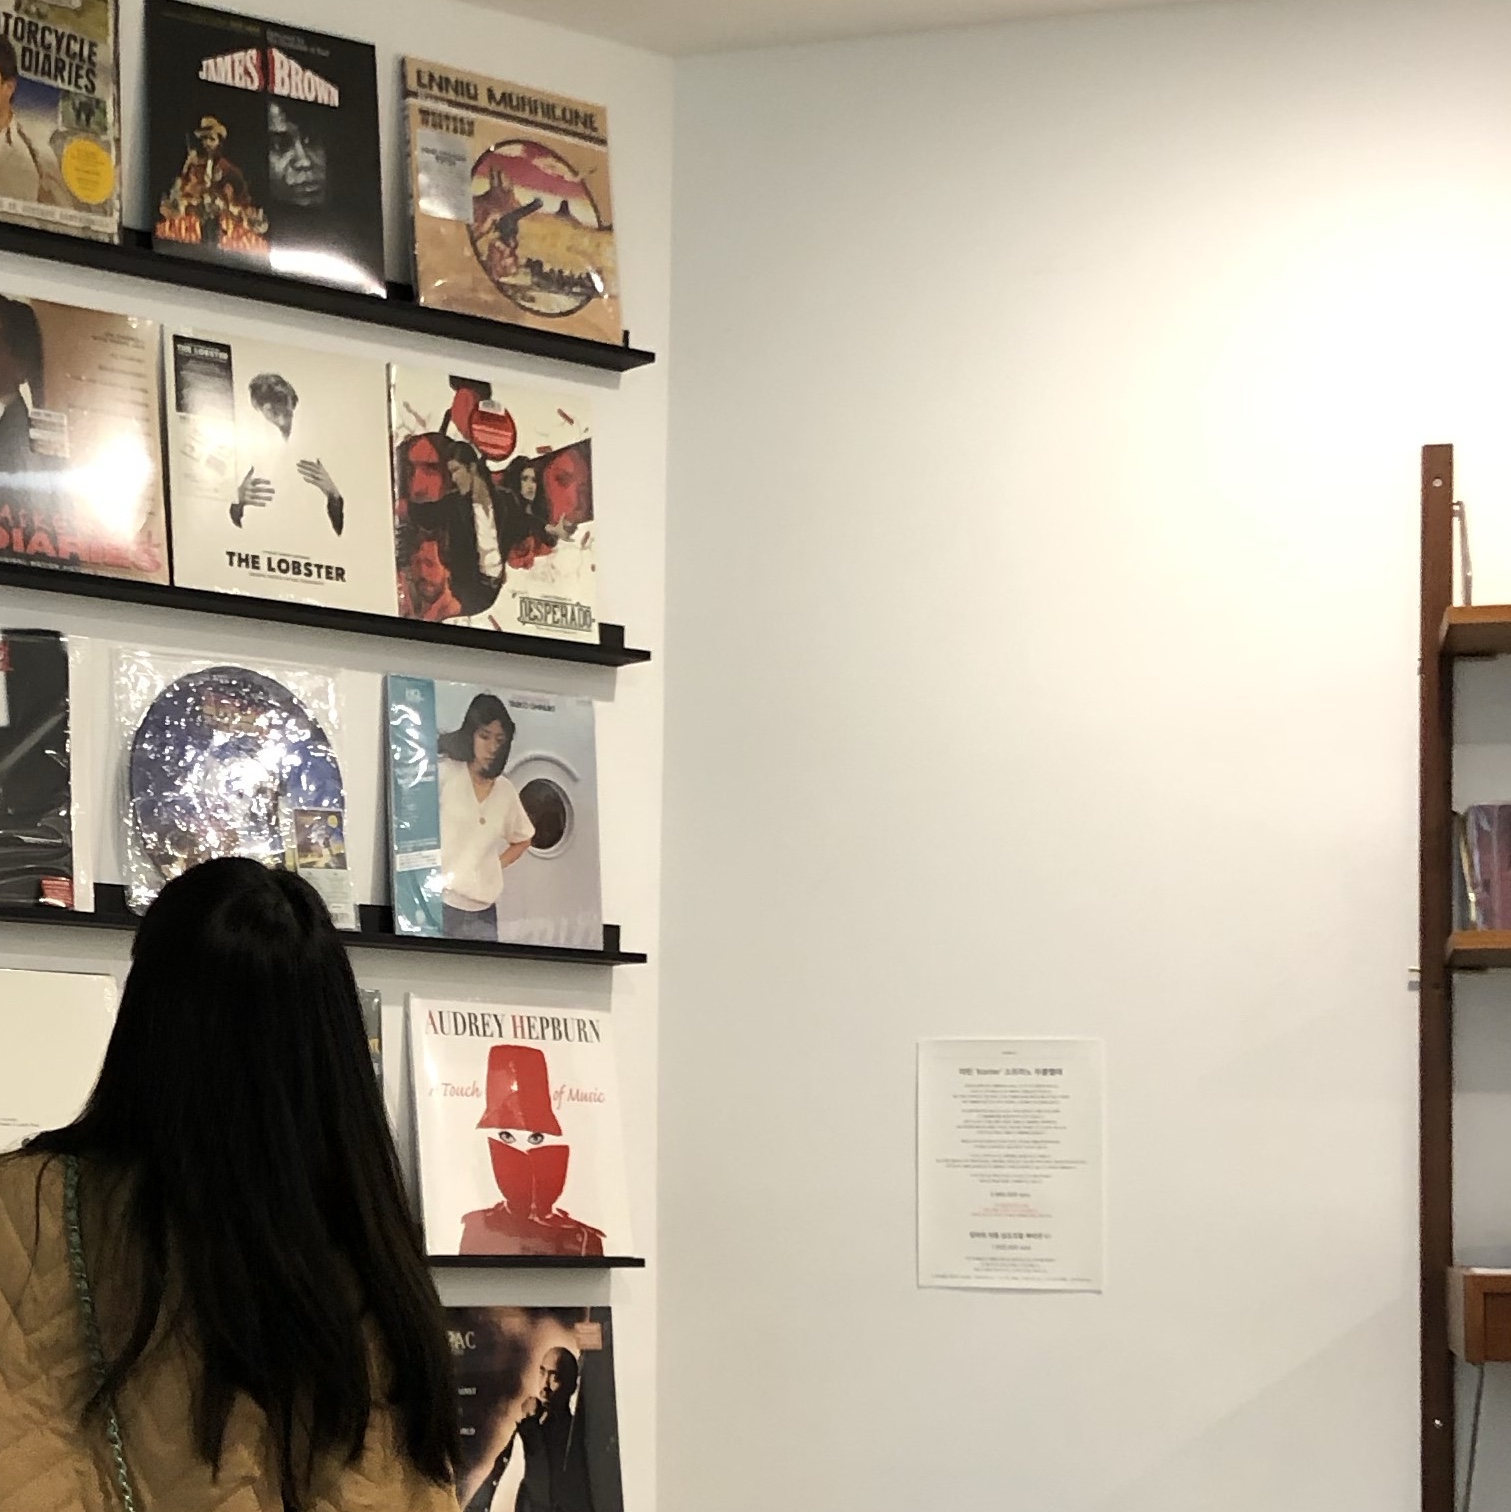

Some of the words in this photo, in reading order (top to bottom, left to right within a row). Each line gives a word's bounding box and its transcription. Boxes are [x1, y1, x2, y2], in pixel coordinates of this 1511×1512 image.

[20, 47, 97, 94] DIARIES
[198, 47, 261, 91] JAMES
[271, 47, 340, 108] BROWN
[225, 550, 261, 570] THE
[266, 556, 346, 583] LOBSTER
[518, 599, 593, 631] DESPERADO
[425, 1009, 505, 1038] AUDREY
[512, 1014, 601, 1043] HEPBURN
[441, 1081, 481, 1098] Touch
[553, 1083, 566, 1109] of
[567, 1086, 605, 1103] Music
